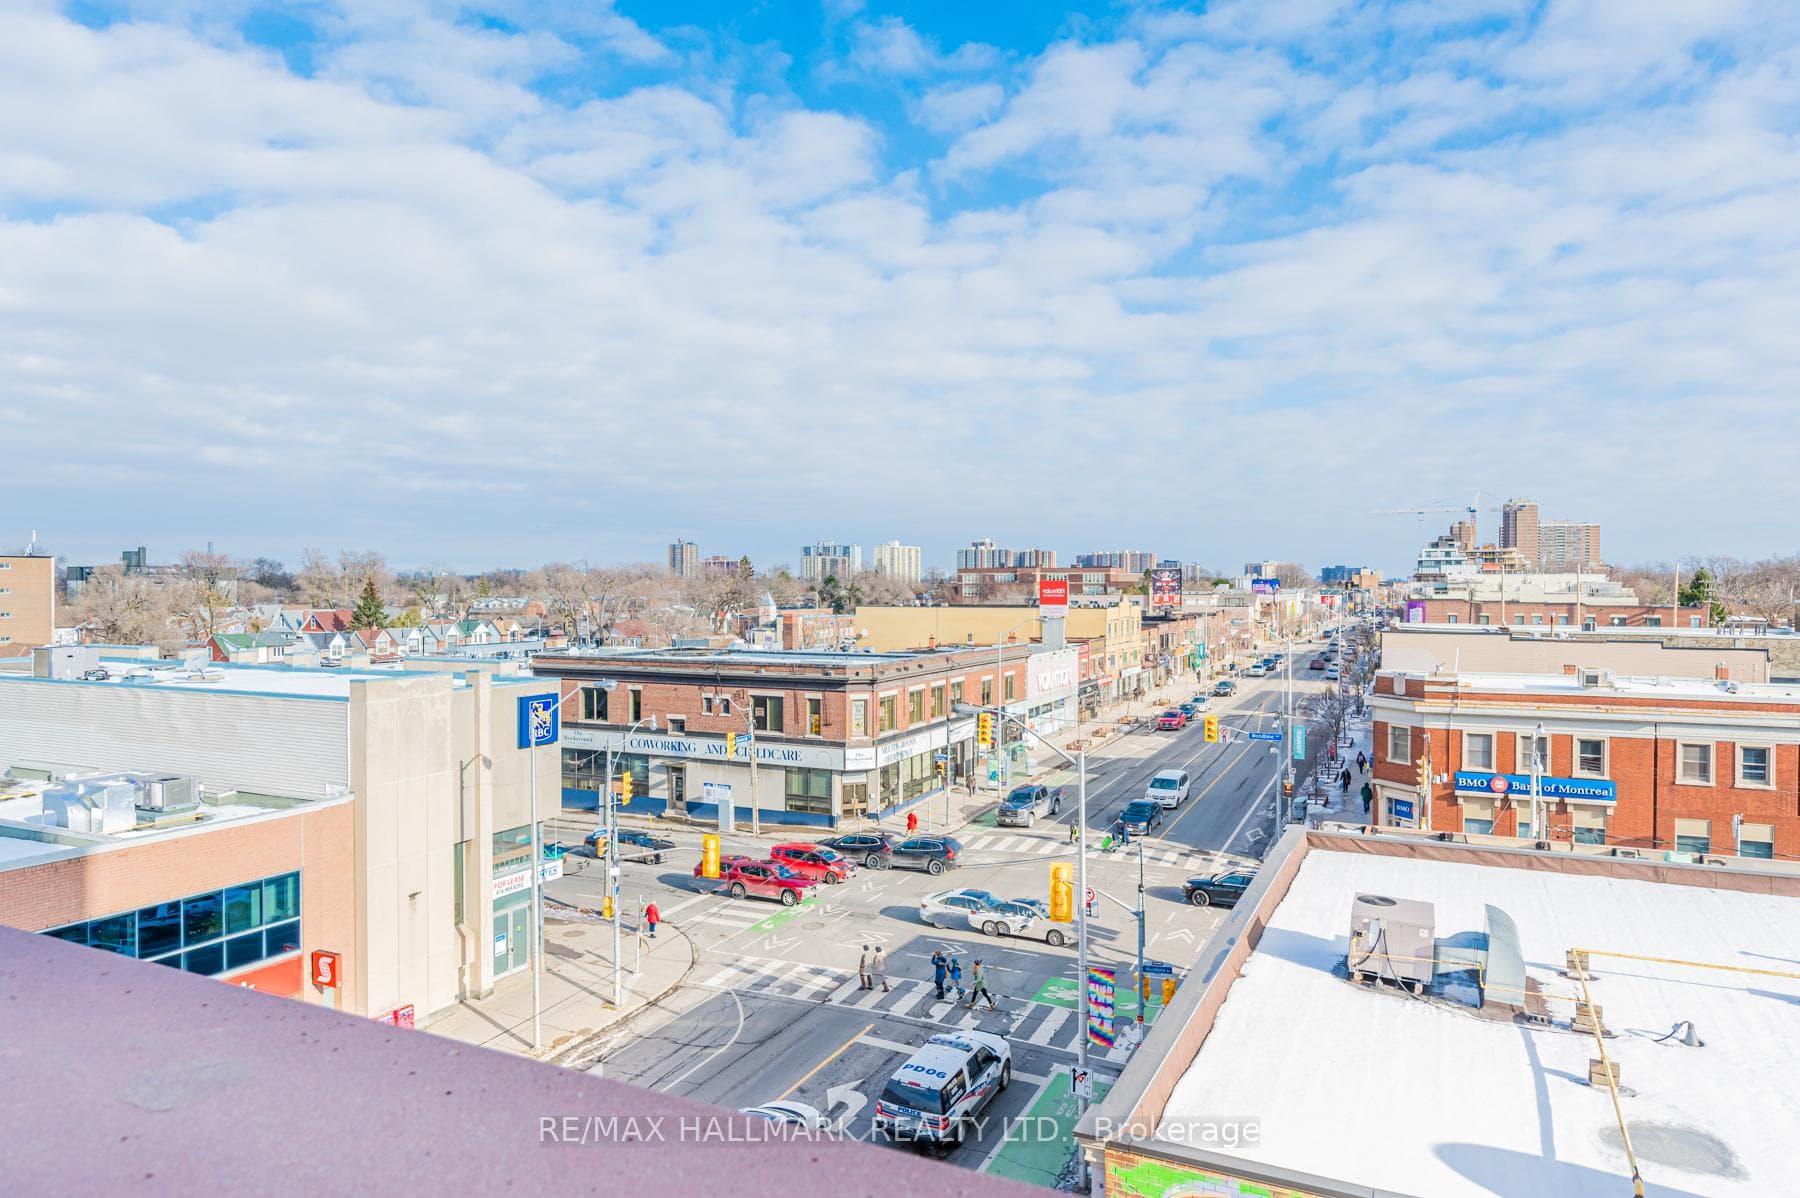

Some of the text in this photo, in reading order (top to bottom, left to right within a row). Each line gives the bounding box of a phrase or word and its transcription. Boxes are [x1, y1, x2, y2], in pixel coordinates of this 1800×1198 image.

[630, 739, 802, 762] COWORKING AND CHLDCARE
[1458, 777, 1488, 788] BMO
[1543, 783, 1557, 793] of
[1558, 784, 1613, 797] Montreal
[1396, 804, 1410, 812] BMO
[902, 1063, 947, 1079] PD06
[897, 1106, 922, 1116] POLICE
